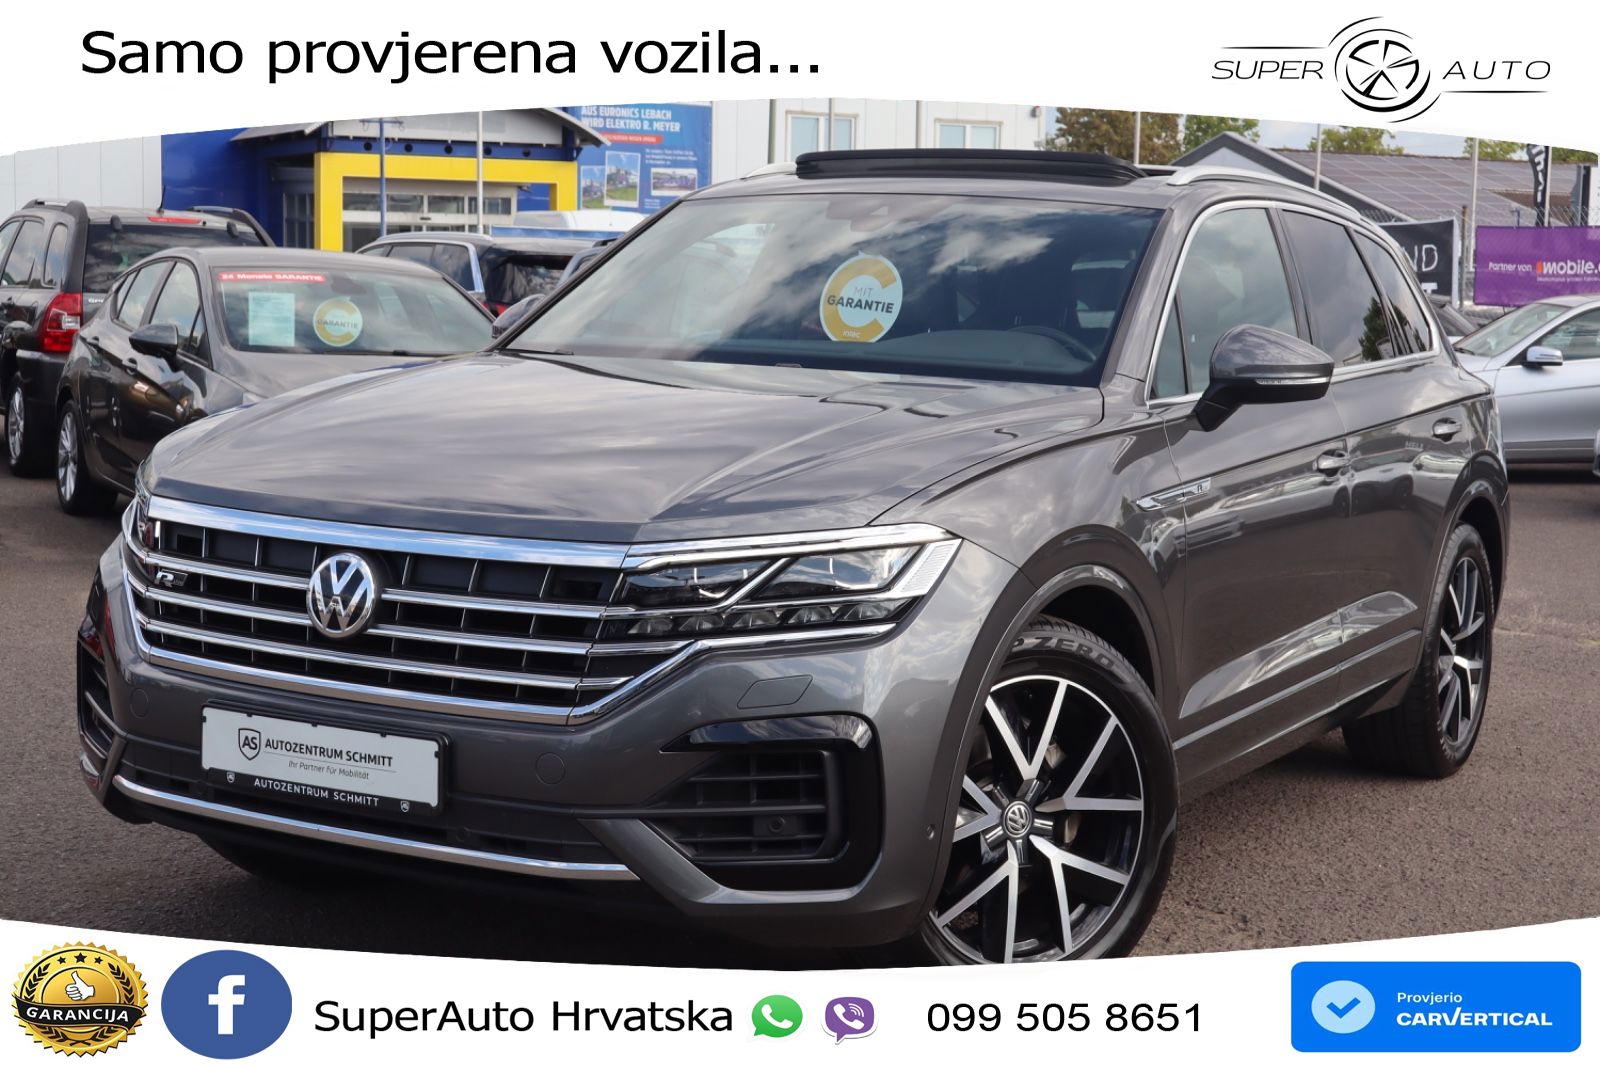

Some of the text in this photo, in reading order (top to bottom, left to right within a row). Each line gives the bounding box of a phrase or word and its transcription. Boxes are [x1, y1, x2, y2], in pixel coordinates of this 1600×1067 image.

[581, 107, 672, 120] AUS EURONICS LEBACH
[606, 119, 641, 129] ELEKTRO
[653, 122, 681, 132] MEYER
[1488, 262, 1516, 271] Partner
[854, 287, 874, 297] MIT
[827, 295, 894, 313] GARANTIE
[317, 318, 359, 329] GARANTIE
[1033, 637, 1114, 669] ZERO
[242, 735, 393, 767] AS AUTOZENTRUM SCHMITT
[299, 762, 325, 774] Partner
[326, 764, 337, 775] für
[338, 767, 369, 780] Mobilität
[253, 778, 379, 807] AUTOZENTRUM SCHMITT
